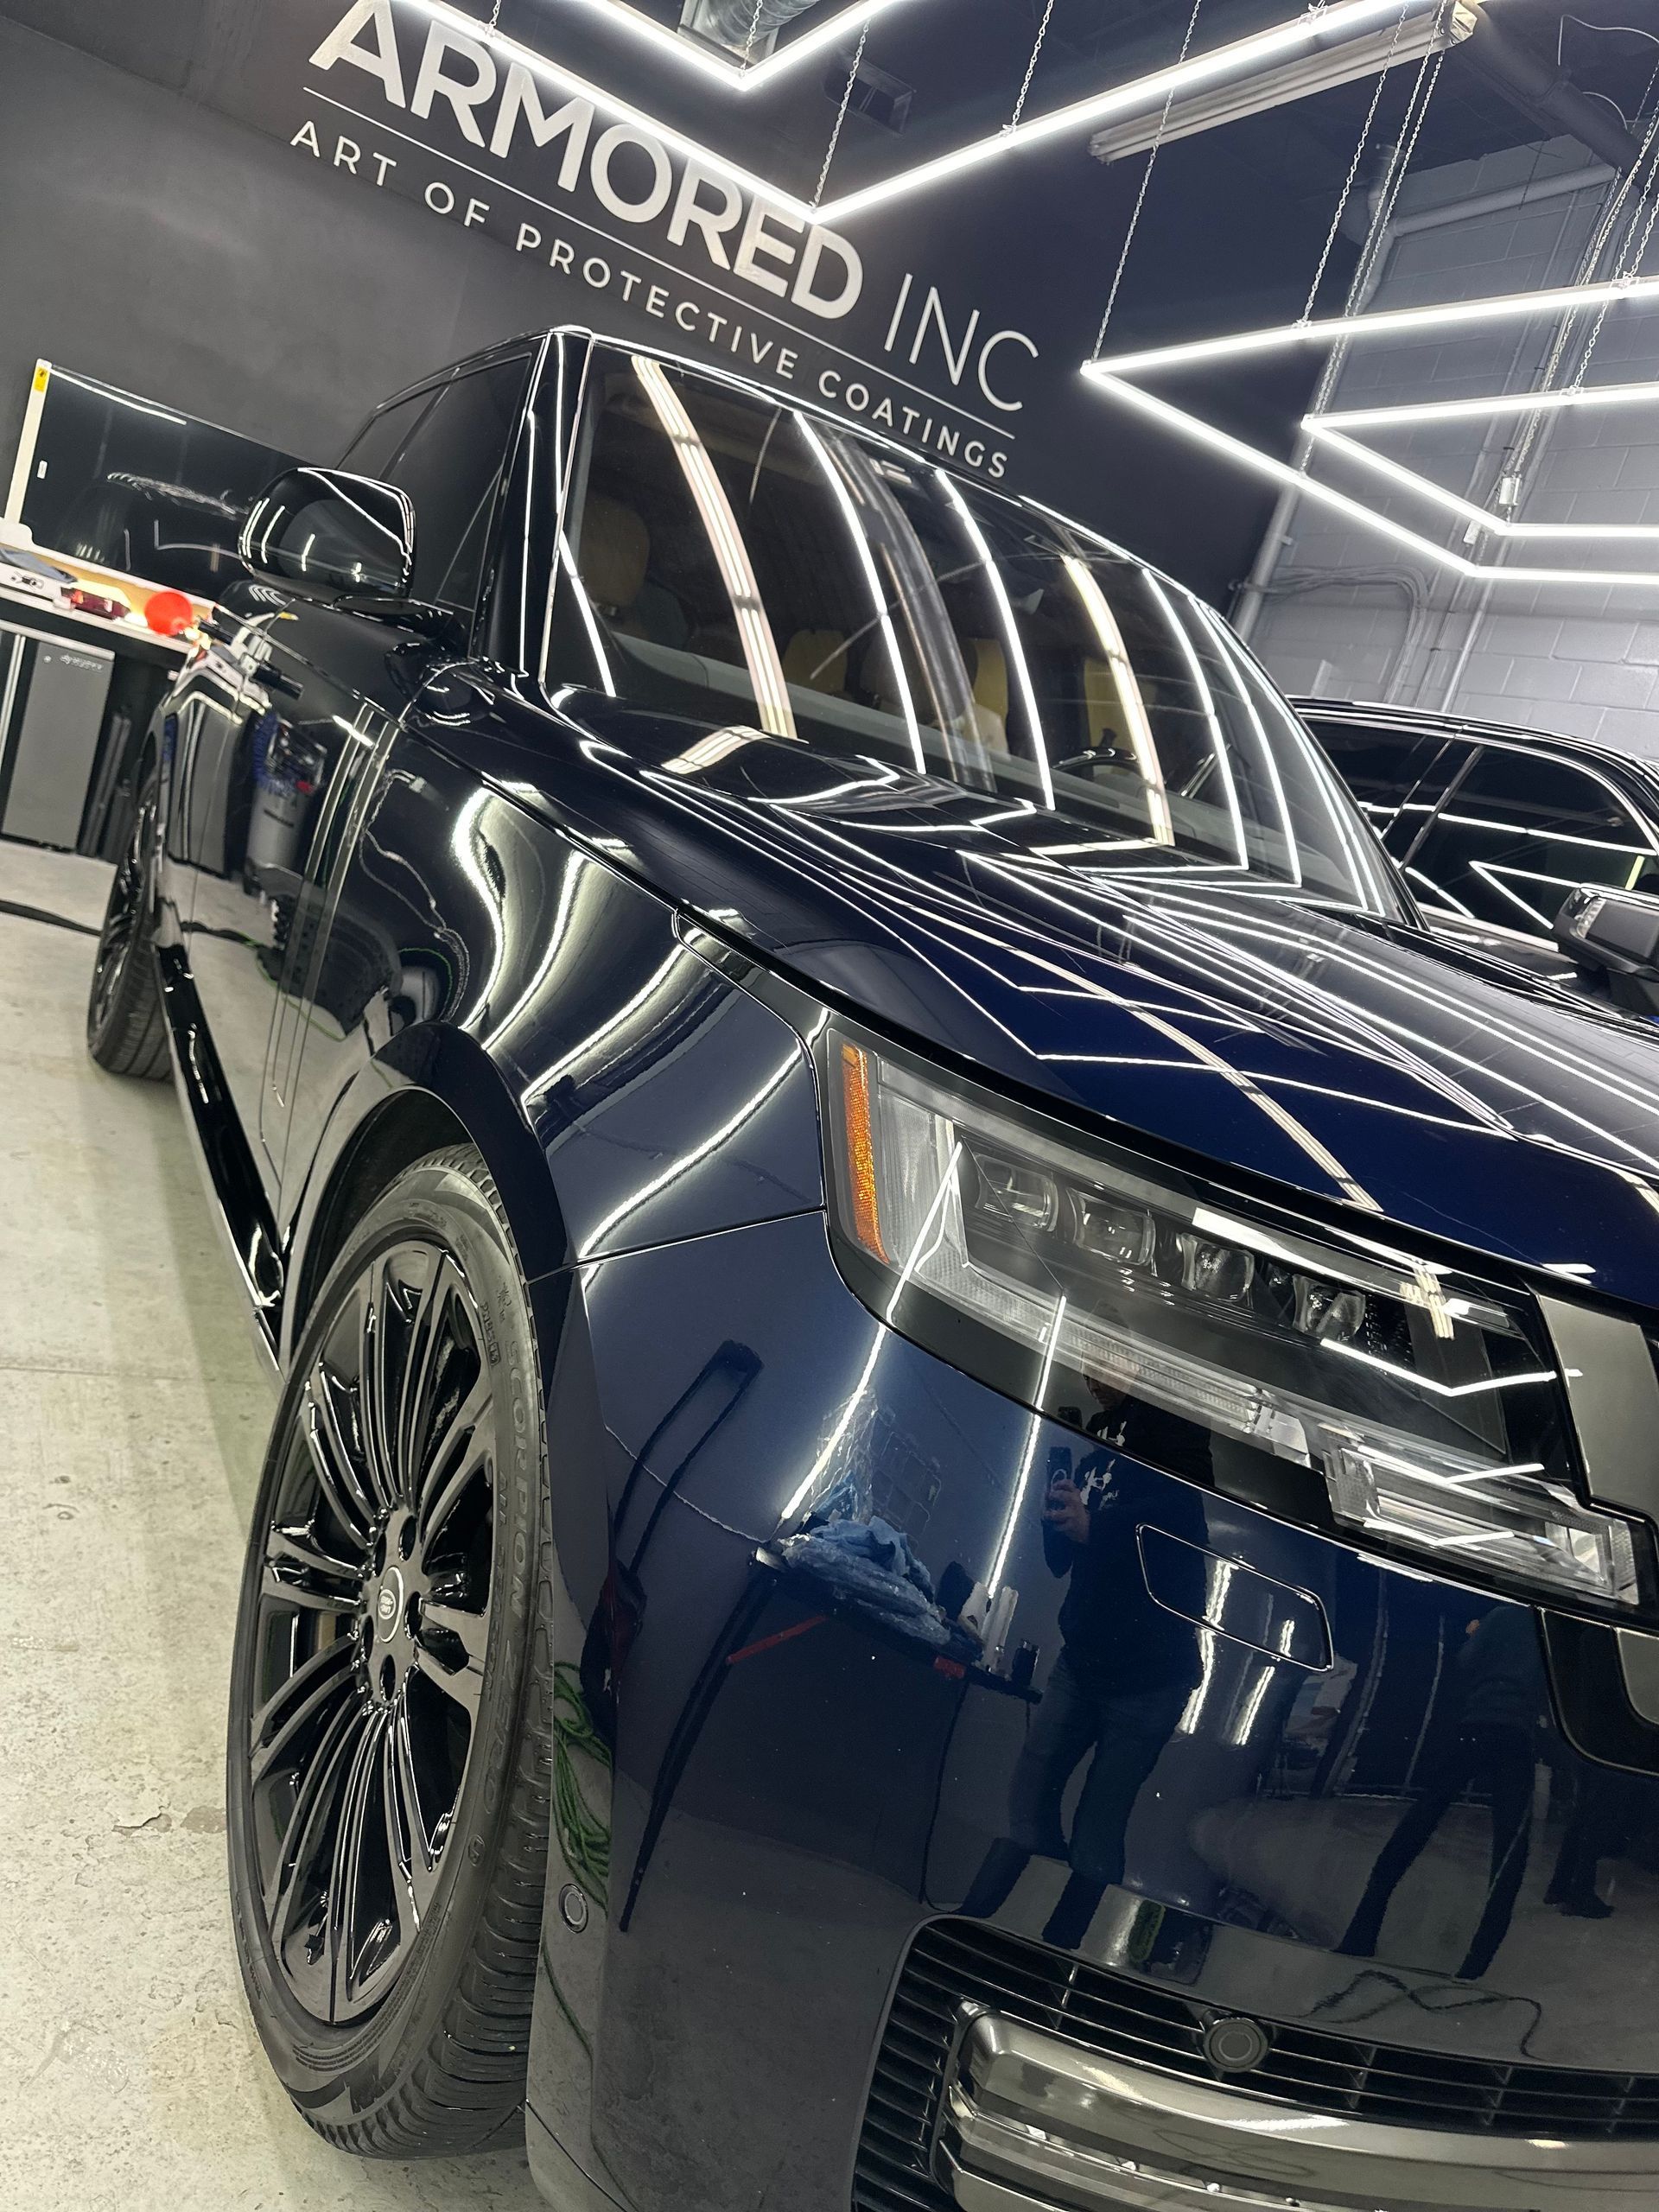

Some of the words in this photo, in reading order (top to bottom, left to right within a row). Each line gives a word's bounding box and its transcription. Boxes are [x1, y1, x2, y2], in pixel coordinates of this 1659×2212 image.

[290, 120, 397, 187] ART
[424, 181, 490, 227] OF
[516, 223, 798, 379] PROTECTIVE
[819, 370, 1007, 478] COATINGS
[308, 0, 863, 319] ARMORED
[885, 273, 1039, 411] INC
[507, 1340, 529, 1618] SCORPION
